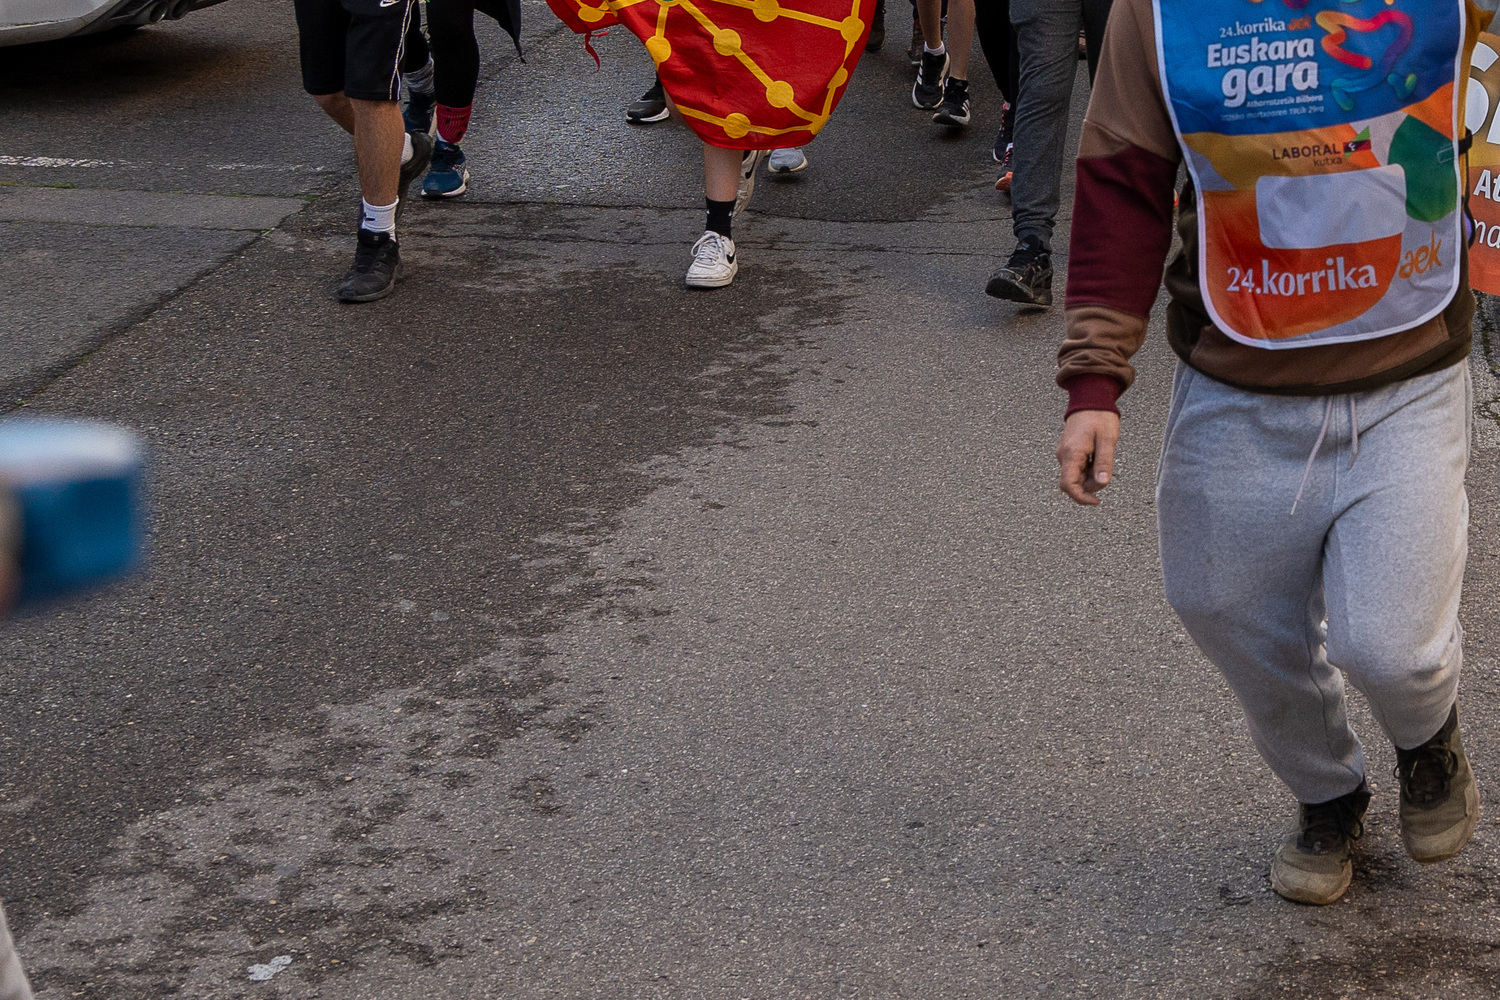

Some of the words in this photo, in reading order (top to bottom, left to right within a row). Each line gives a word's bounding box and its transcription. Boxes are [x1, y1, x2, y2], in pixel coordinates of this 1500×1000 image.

[1219, 17, 1286, 38] 24.korrika
[1207, 36, 1315, 68] Euskara
[1221, 61, 1319, 108] gara
[1272, 143, 1341, 160] LABORAL
[1313, 156, 1343, 168] kutxa
[1226, 256, 1379, 297] 24.korrika
[1399, 230, 1443, 280] aek
